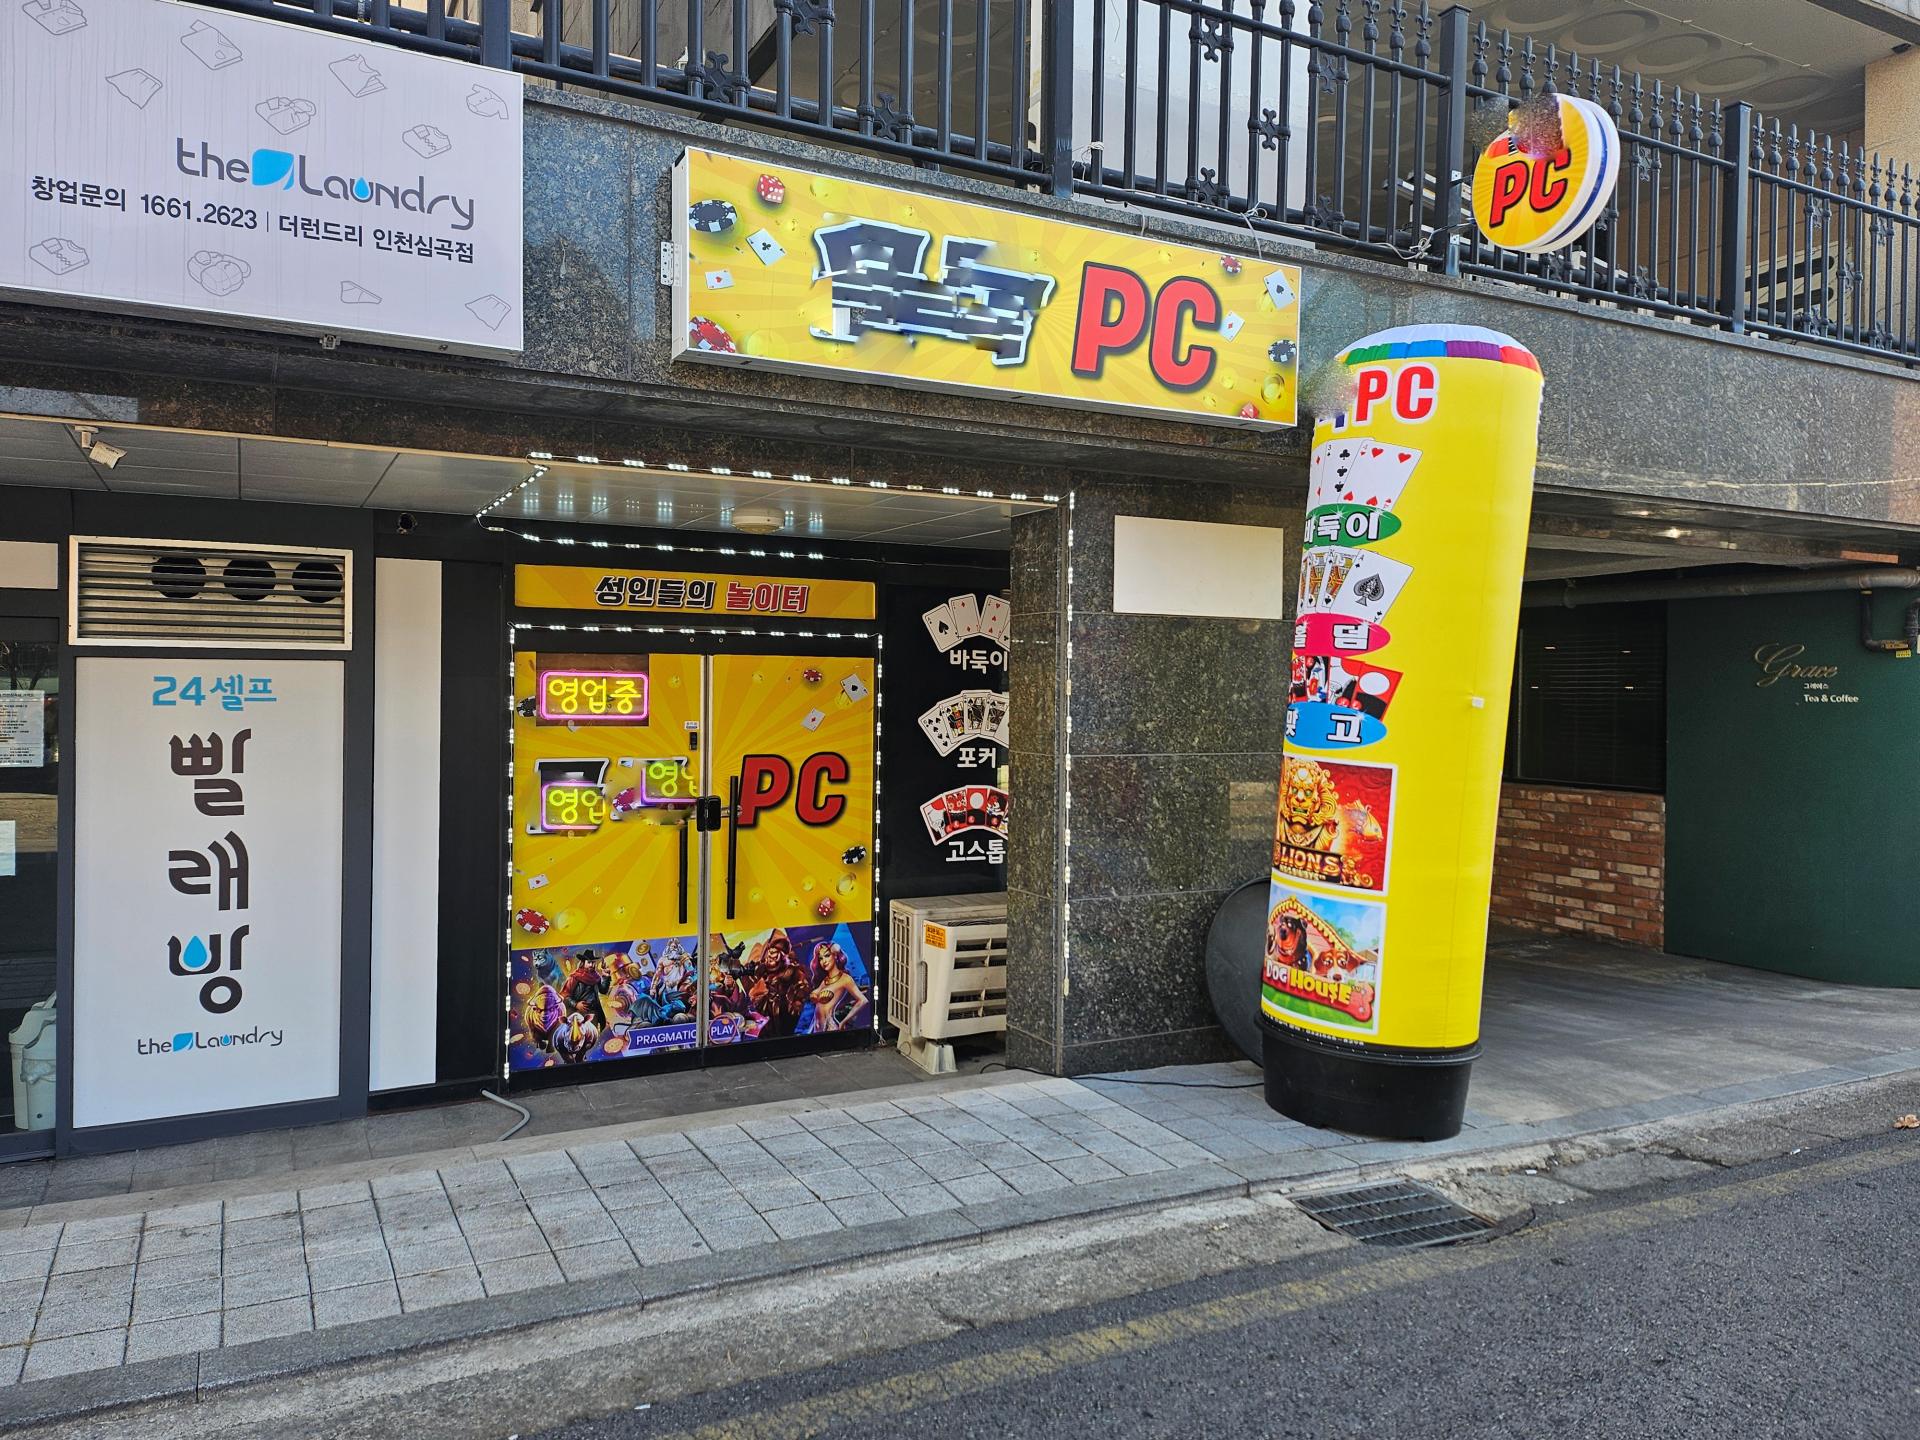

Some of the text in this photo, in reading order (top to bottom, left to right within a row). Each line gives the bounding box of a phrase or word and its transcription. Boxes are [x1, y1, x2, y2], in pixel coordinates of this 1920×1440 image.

[176, 137, 475, 231] the Laundry
[1488, 148, 1572, 229] PC
[31, 175, 474, 264] 창업문의 1661.2623 더런드리 인천심곡점
[1071, 260, 1218, 393] PC
[1354, 364, 1437, 423] PC
[594, 576, 808, 612] 성인들의 놀이터
[950, 650, 1008, 675] 바둑이
[548, 678, 642, 714] 영업중
[1803, 694, 1820, 703] Tea
[1830, 694, 1859, 703] Coffee
[957, 747, 997, 769] 포커
[736, 751, 850, 830] PC
[945, 839, 1007, 865] 고스톱
[137, 1025, 283, 1056] the Laundry
[710, 1024, 734, 1037] PLAY
